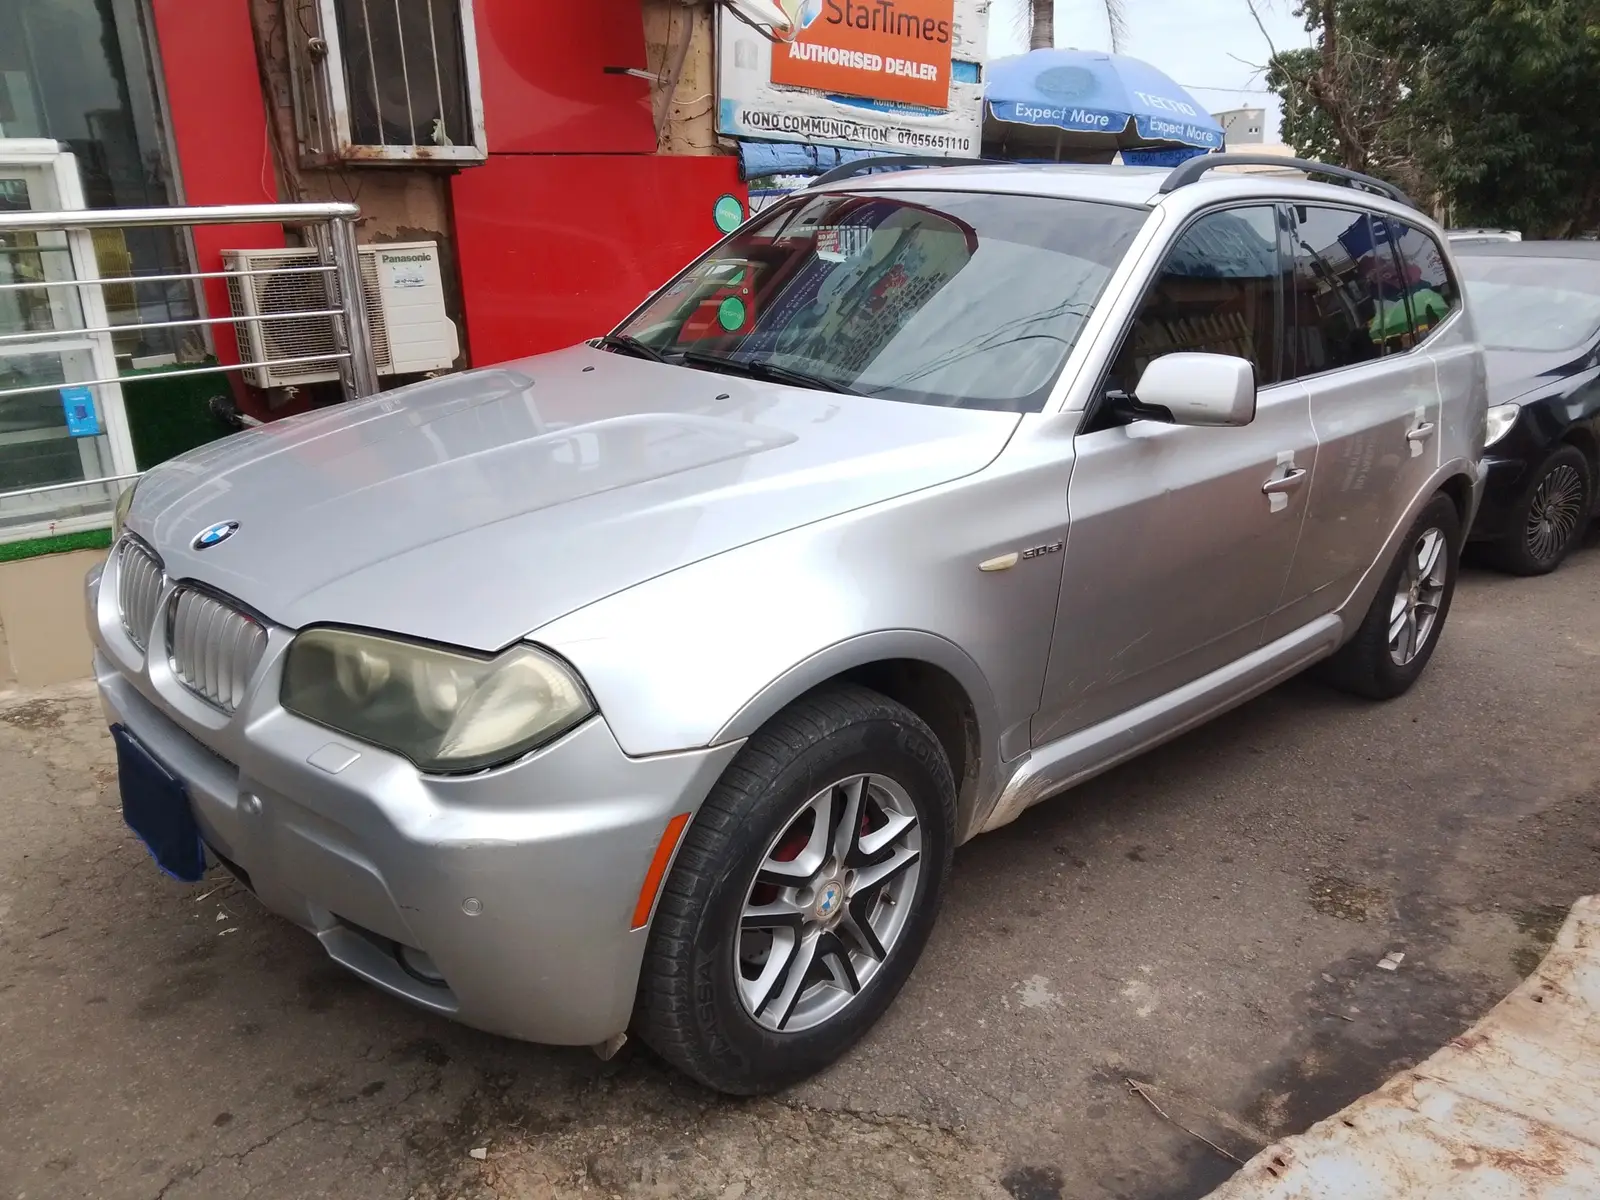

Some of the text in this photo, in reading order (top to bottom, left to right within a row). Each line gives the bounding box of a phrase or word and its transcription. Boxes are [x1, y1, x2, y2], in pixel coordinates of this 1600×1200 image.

[826, 0, 949, 43] StarTimes
[789, 41, 937, 82] AUTHORISED DEALER
[1015, 102, 1109, 126] Expect More
[1134, 91, 1197, 117] TECNO
[742, 110, 969, 151] KONO COMMUNICATION 07055651110
[1150, 116, 1213, 142] Expect More
[382, 253, 431, 263] Panasonic
